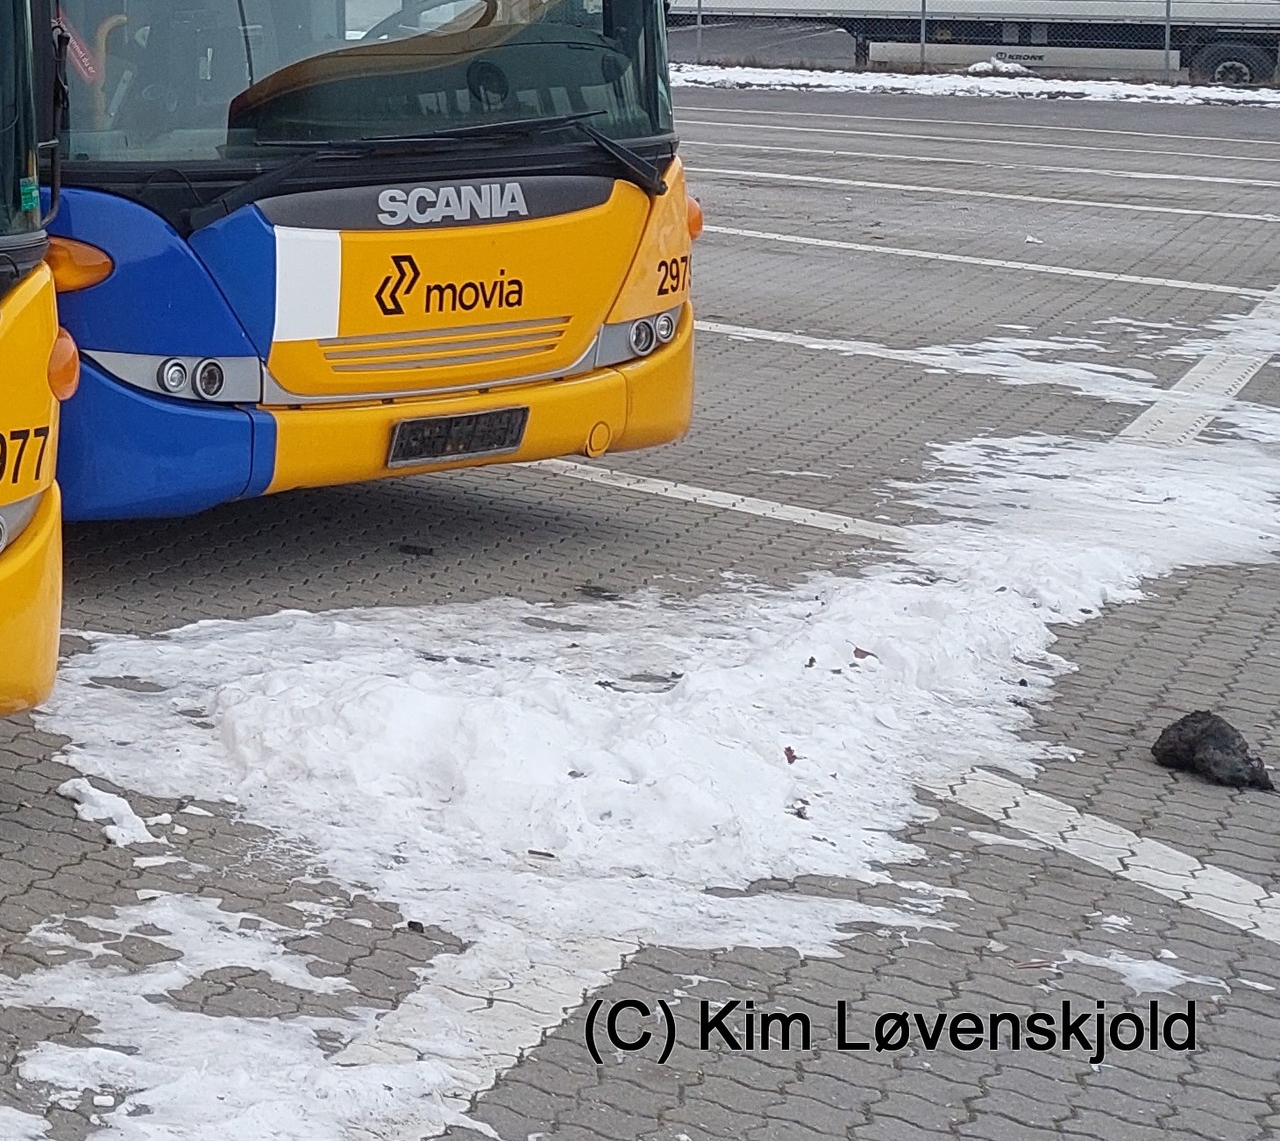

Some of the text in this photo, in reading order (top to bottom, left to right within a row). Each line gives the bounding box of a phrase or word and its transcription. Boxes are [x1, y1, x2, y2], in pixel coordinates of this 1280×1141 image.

[378, 183, 529, 226] SCANIA
[425, 269, 523, 313] movia
[657, 254, 692, 296] 297
